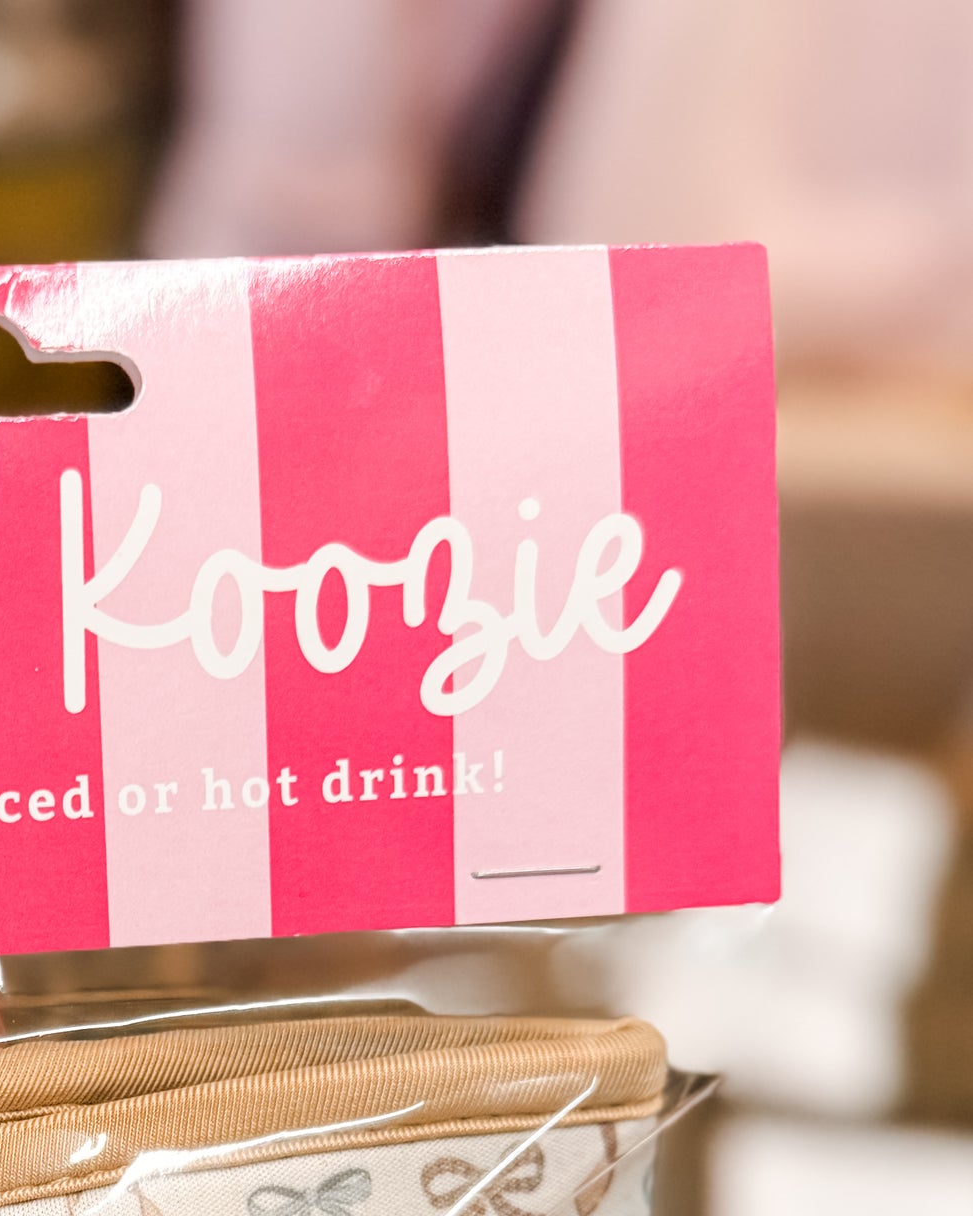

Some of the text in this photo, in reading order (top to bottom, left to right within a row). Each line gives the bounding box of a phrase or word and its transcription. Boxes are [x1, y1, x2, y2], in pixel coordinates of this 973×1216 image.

[60, 468, 683, 717] Koozie
[118, 780, 180, 815] or
[201, 766, 299, 811] hot
[322, 751, 506, 805] drink!
